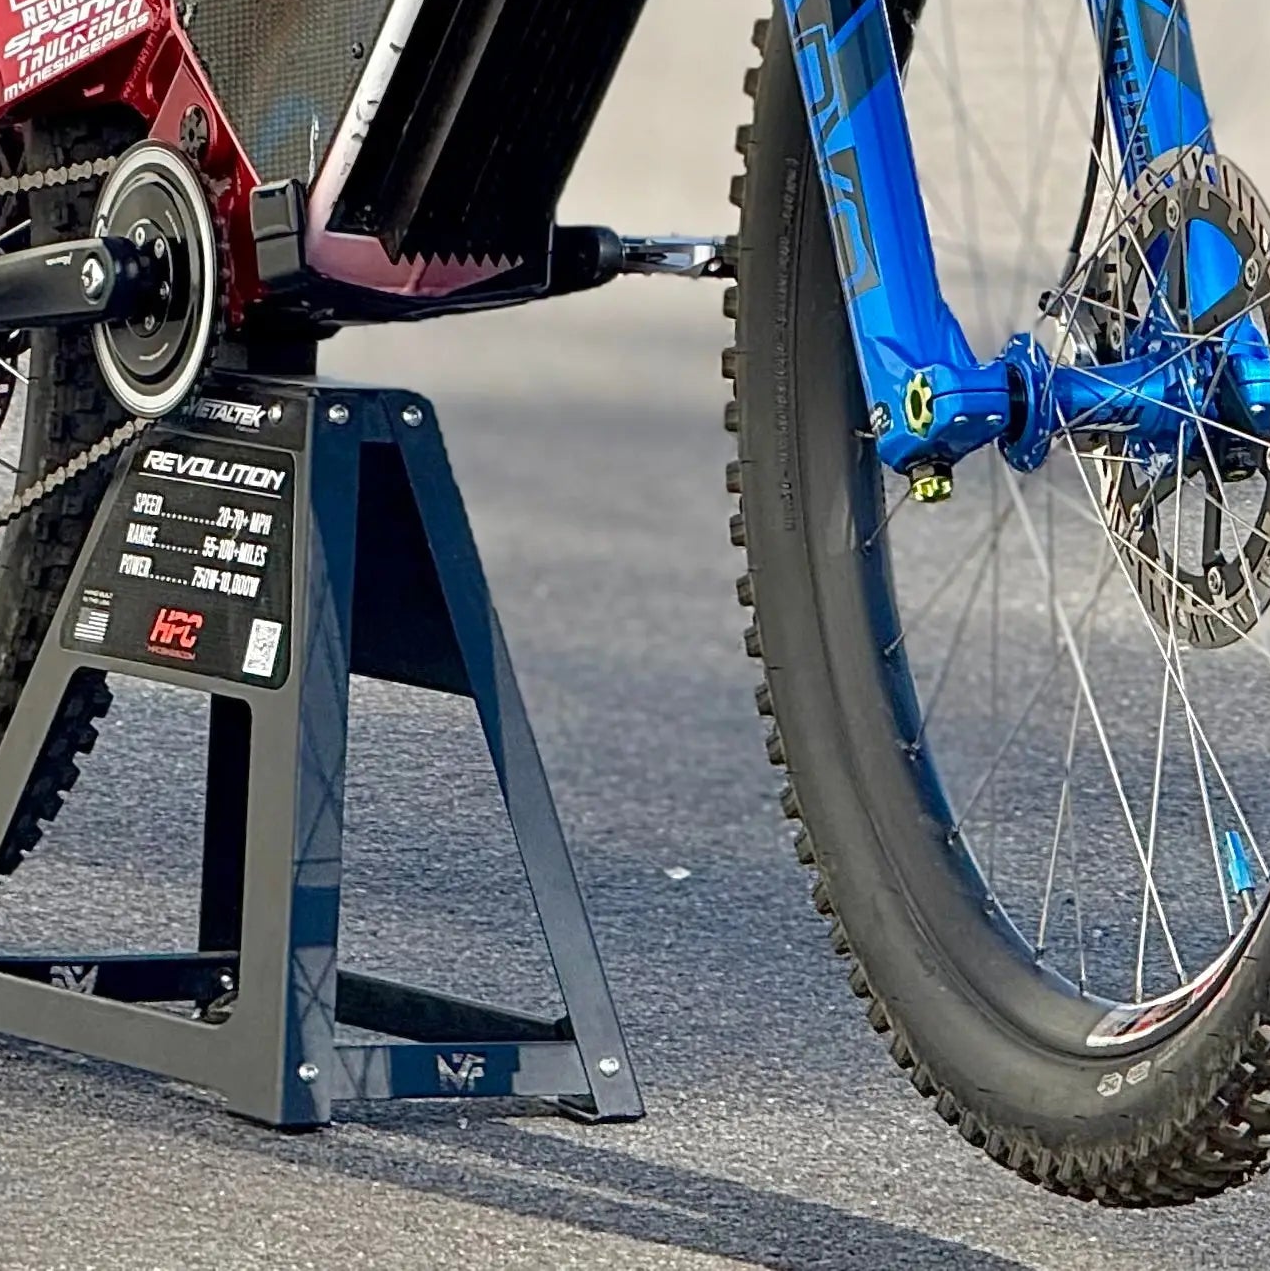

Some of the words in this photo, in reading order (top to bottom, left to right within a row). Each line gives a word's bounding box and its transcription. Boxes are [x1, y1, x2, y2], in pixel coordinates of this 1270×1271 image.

[142, 449, 286, 491] REVOLUTION
[248, 511, 273, 536] MPH
[149, 608, 203, 649] HPC
